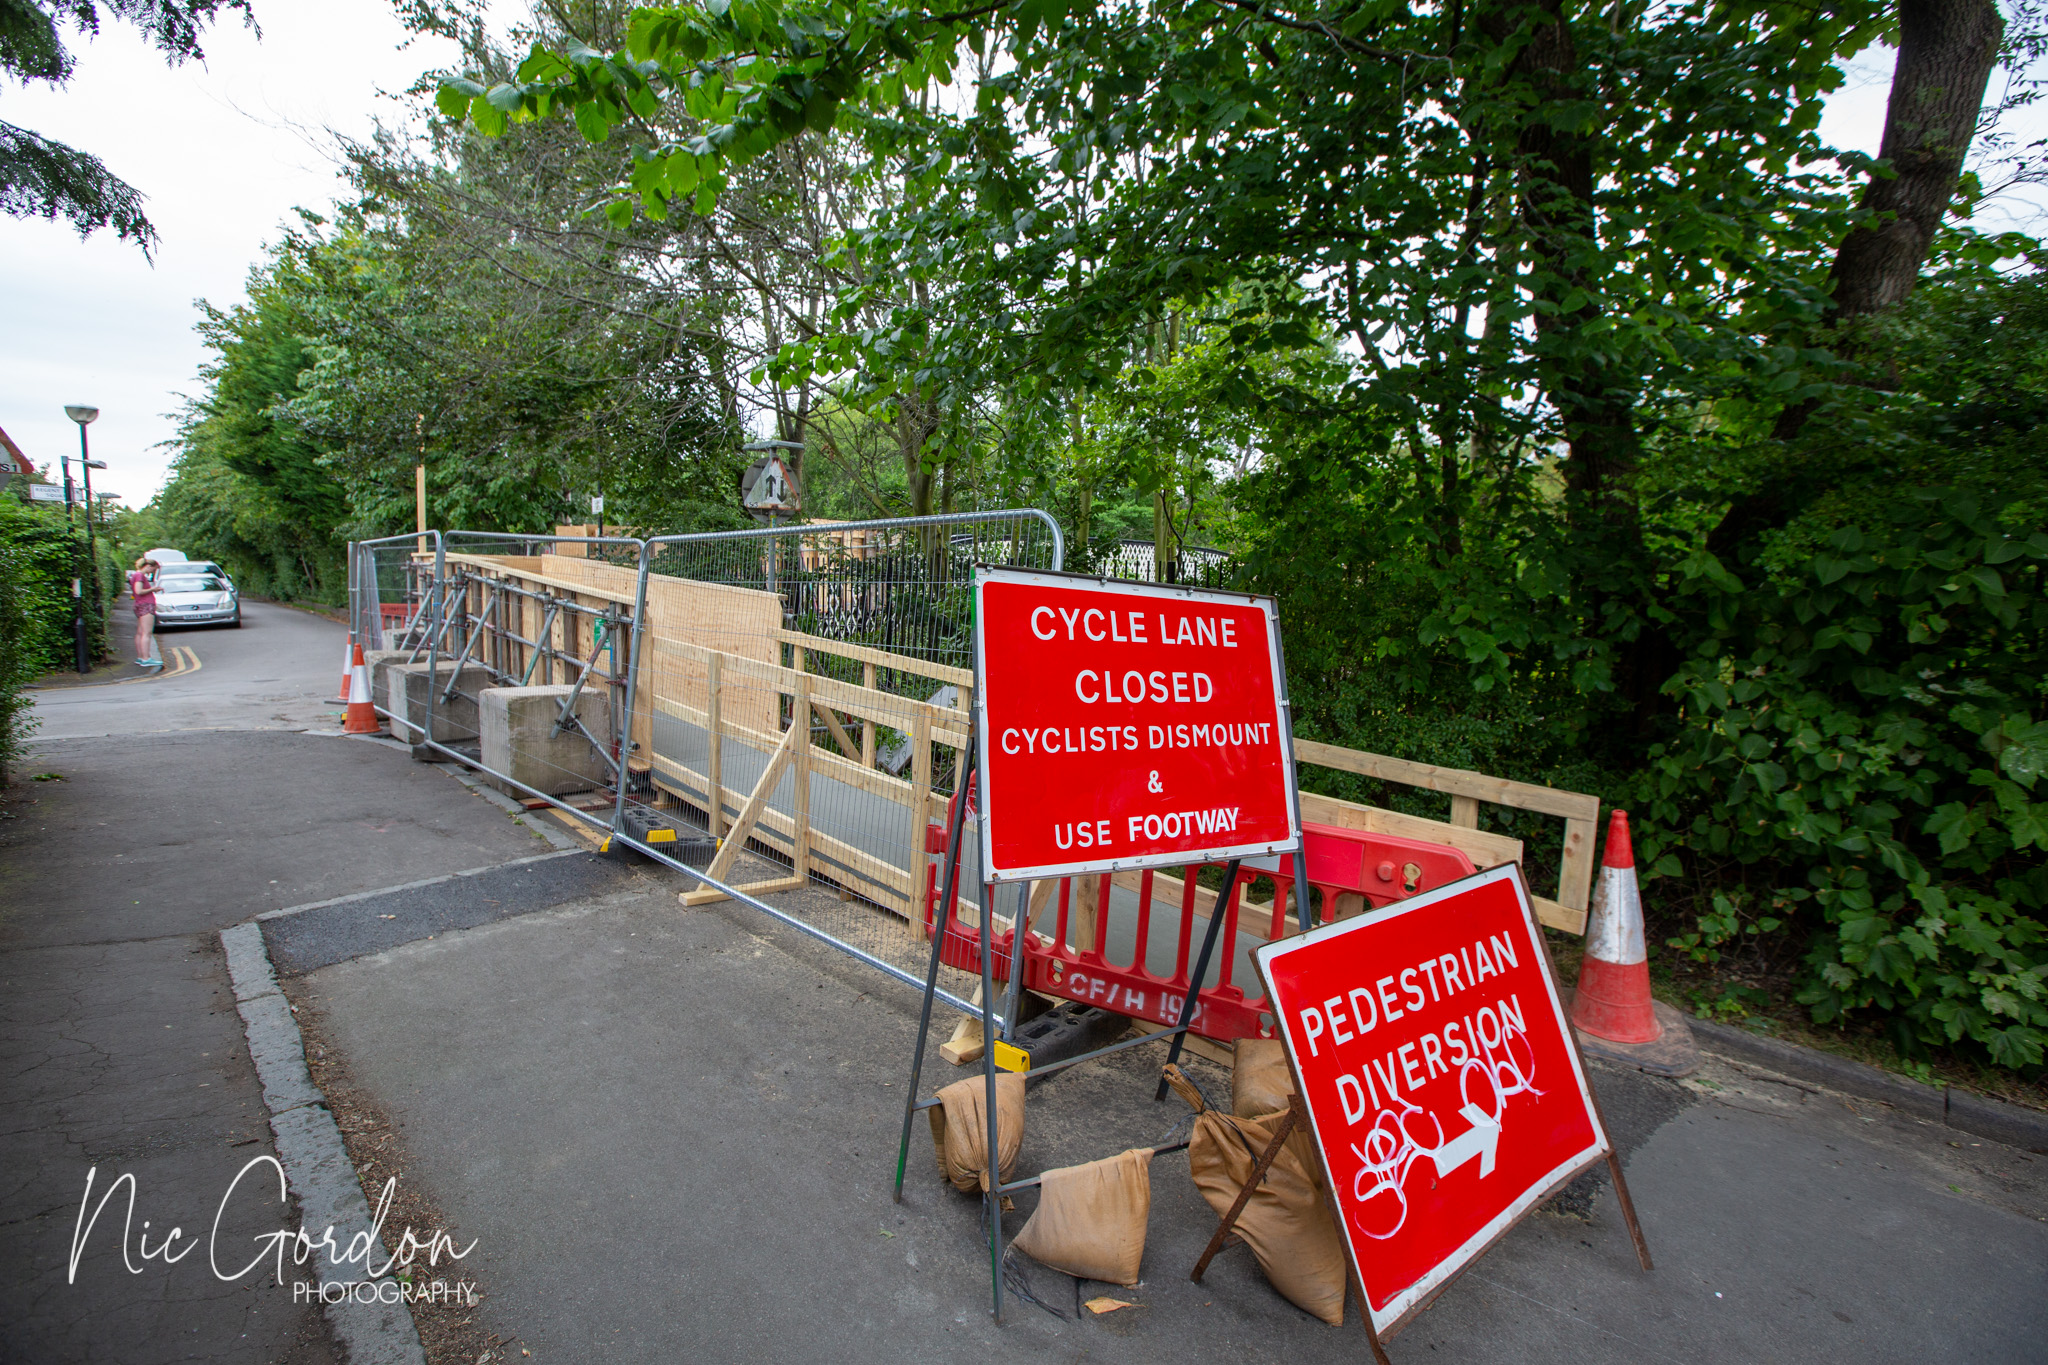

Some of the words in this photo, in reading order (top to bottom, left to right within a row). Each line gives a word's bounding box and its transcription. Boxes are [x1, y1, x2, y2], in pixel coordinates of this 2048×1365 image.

[1030, 605, 1148, 644] CYCLE
[1159, 613, 1238, 648] LANE
[1075, 669, 1213, 704] CLOSED
[1001, 725, 1139, 755] CYCLISTS
[1148, 722, 1271, 750] DISMOUNT
[1147, 769, 1164, 794] &
[1054, 819, 1112, 850] USE
[1128, 807, 1239, 842] FOOTWAY
[1300, 930, 1519, 1057] PEDESTRIAN
[1335, 994, 1527, 1126] DIVERSION
